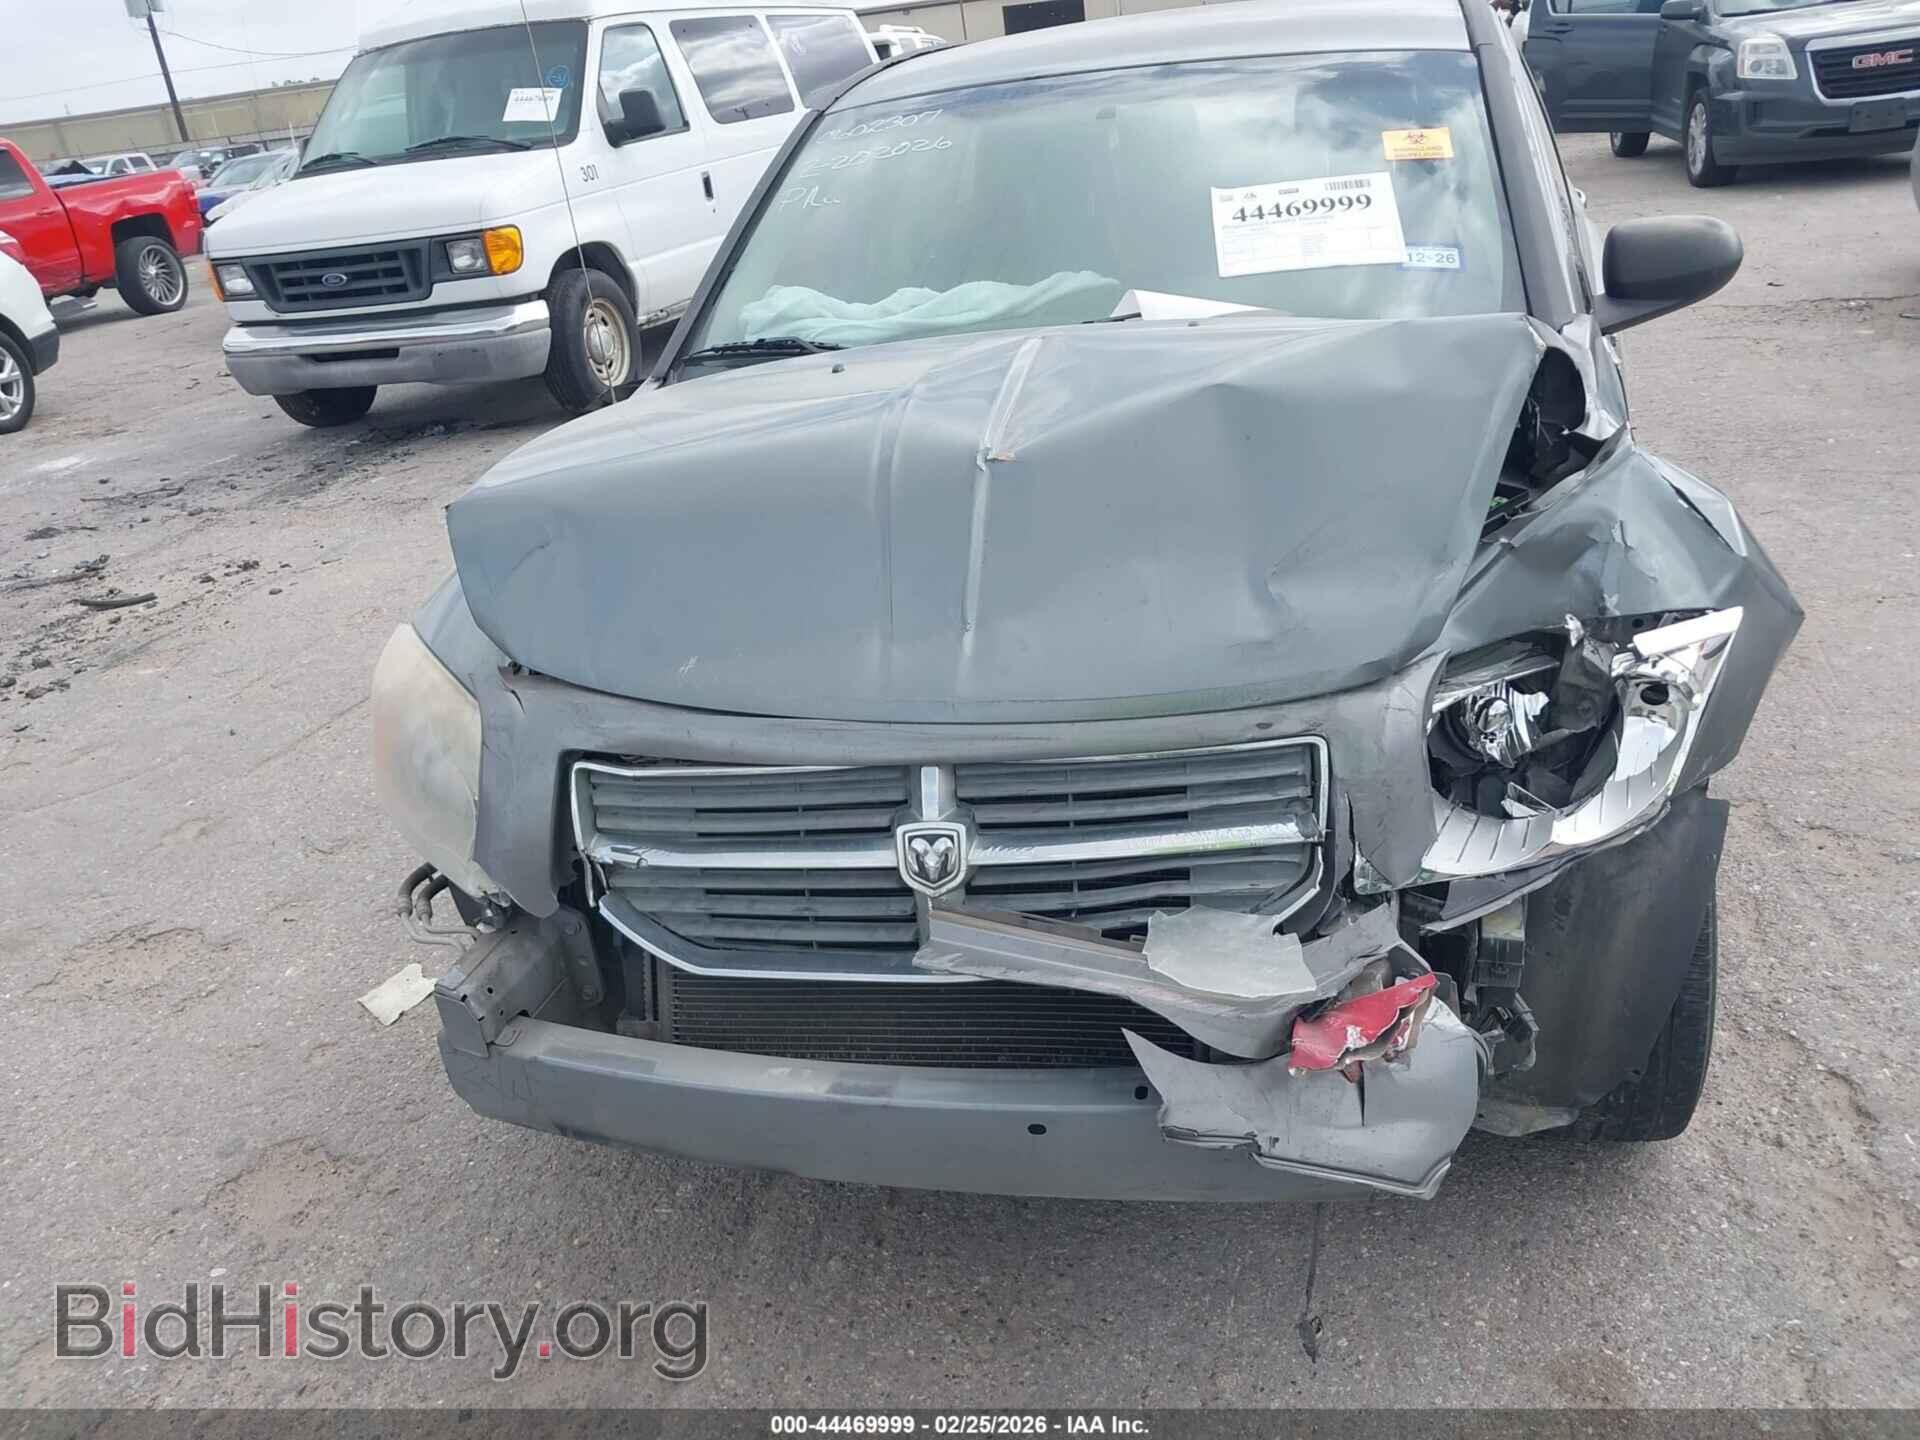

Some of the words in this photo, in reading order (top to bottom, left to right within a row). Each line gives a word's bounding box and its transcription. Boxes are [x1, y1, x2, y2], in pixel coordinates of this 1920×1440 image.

[1852, 48, 1913, 69] GMC
[580, 164, 599, 182] 301
[1231, 193, 1372, 223] 44469999
